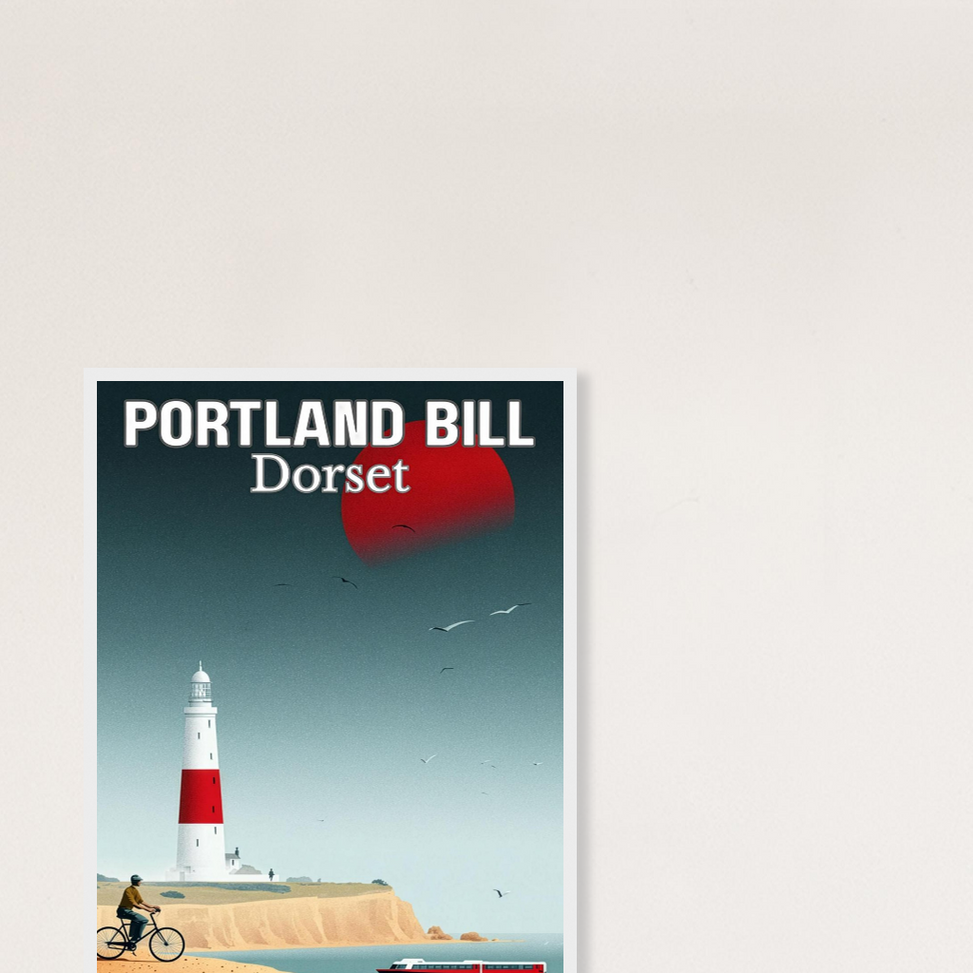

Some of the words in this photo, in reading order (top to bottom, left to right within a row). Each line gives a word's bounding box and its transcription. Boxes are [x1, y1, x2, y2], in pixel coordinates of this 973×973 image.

[125, 399, 405, 447] PORTLAND
[425, 399, 535, 447] BILL
[250, 452, 411, 494] Dorset
